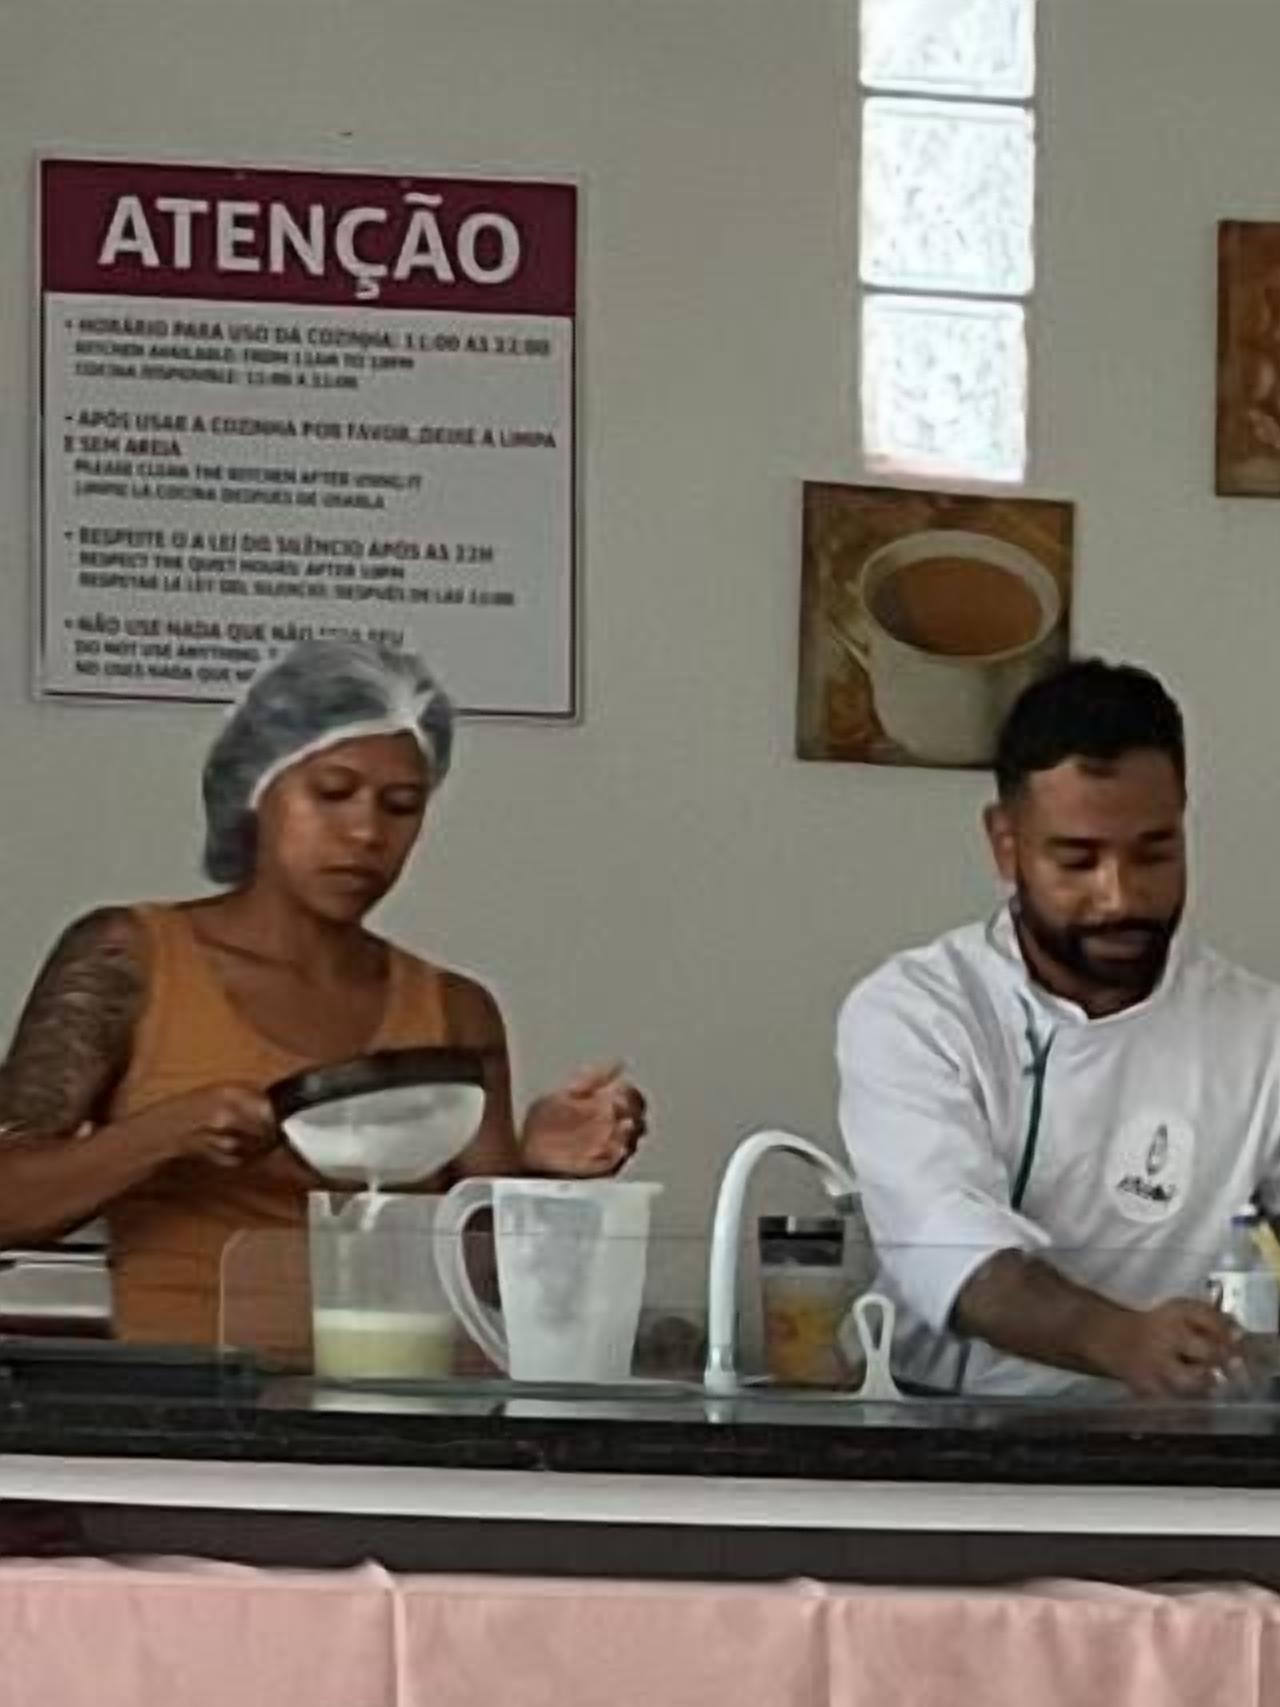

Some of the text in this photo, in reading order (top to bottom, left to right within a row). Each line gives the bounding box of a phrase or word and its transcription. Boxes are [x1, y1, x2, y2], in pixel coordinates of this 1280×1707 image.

[98, 192, 521, 300] ATENÇÃO
[172, 321, 224, 341] PARA
[227, 324, 269, 343] USO
[274, 327, 302, 344] DA
[78, 408, 129, 430] APÓS
[135, 414, 189, 432] USAR
[192, 415, 207, 433] A
[211, 416, 299, 437] COZINHA
[302, 421, 342, 441] POR
[80, 436, 120, 454] SEM
[124, 438, 182, 457] AREIA
[79, 550, 149, 569] RESPECT
[368, 539, 421, 561] APÓS
[78, 612, 122, 636] NÃO
[124, 618, 161, 638] USE
[166, 619, 223, 640] NADA
[226, 621, 266, 642] QUE
